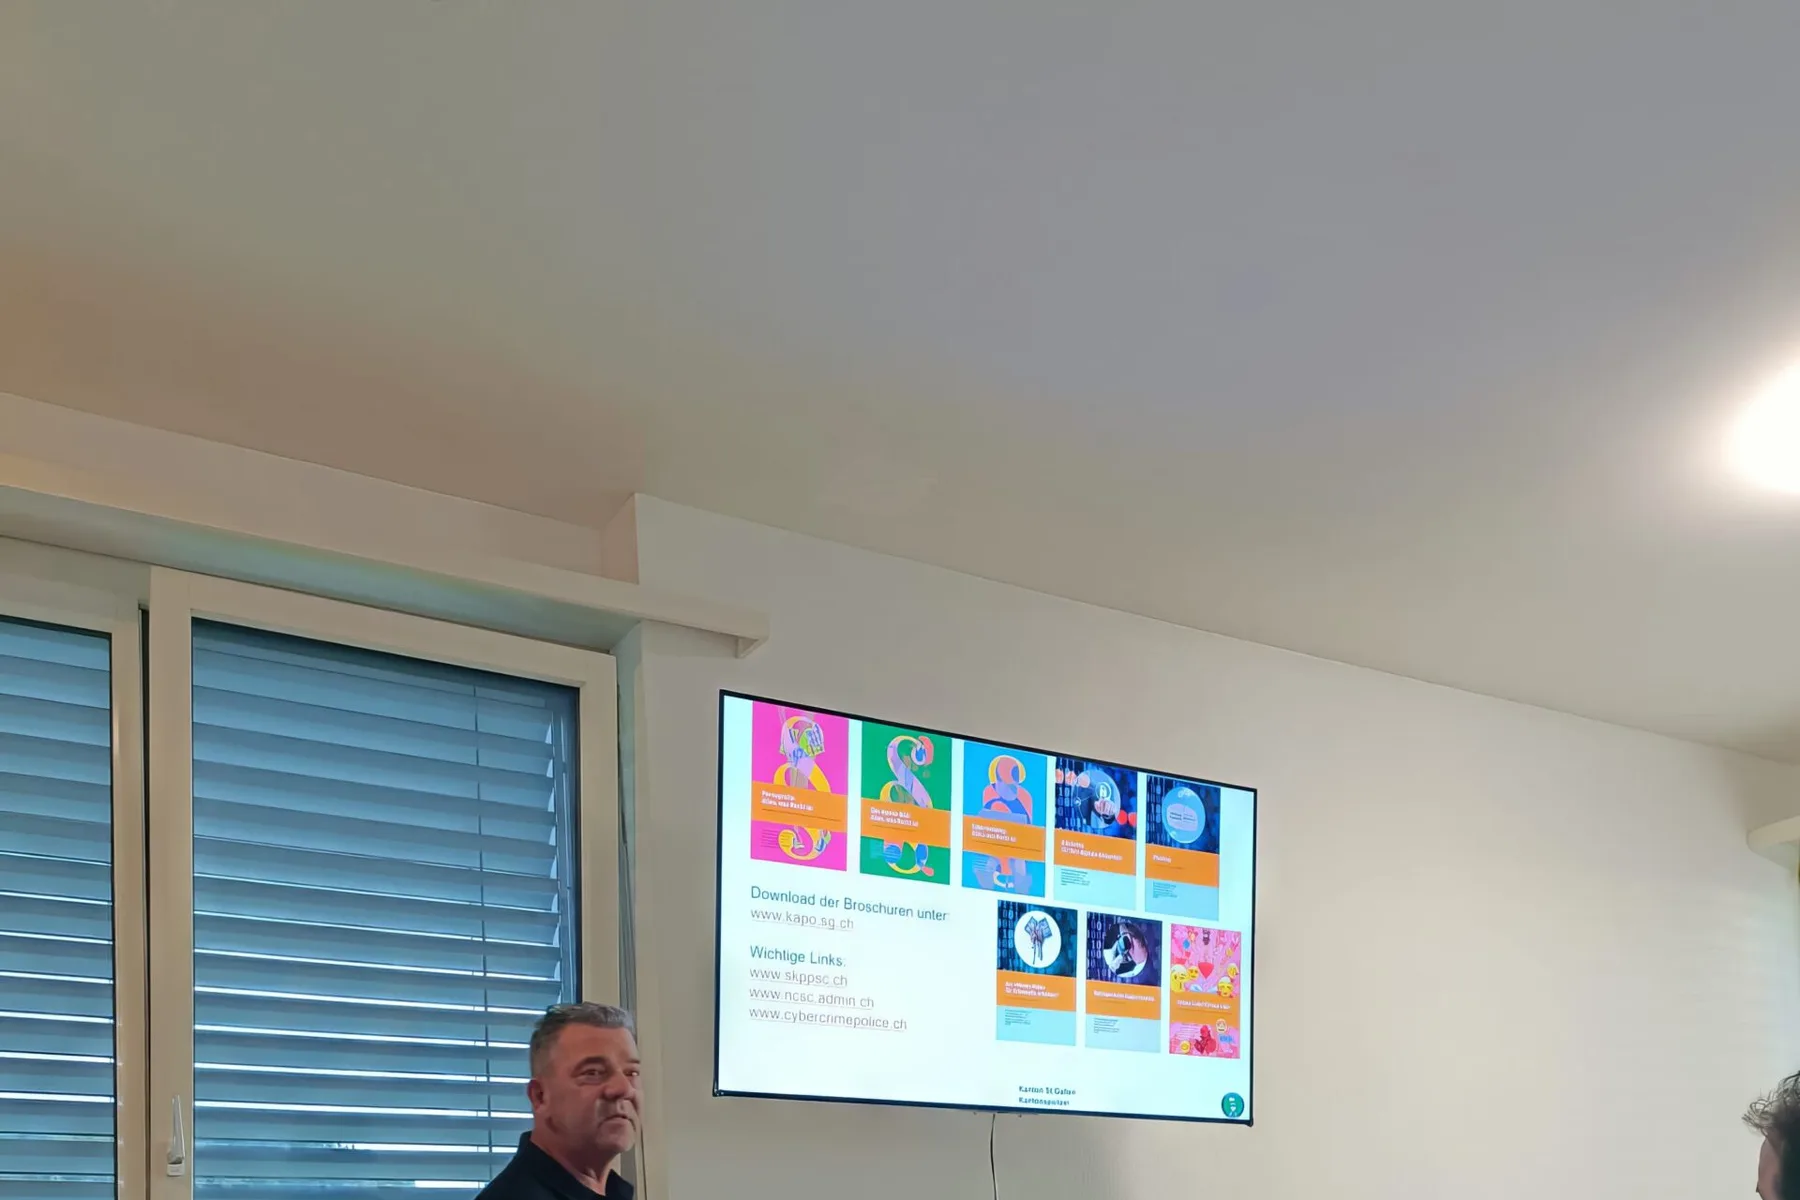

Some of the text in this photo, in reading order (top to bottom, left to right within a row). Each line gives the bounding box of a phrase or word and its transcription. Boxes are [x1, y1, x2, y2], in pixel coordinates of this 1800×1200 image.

[751, 886, 816, 906] Download
[819, 895, 840, 908] der
[750, 909, 854, 931] www.kapo.sg.ch
[750, 945, 806, 965] Wichtige
